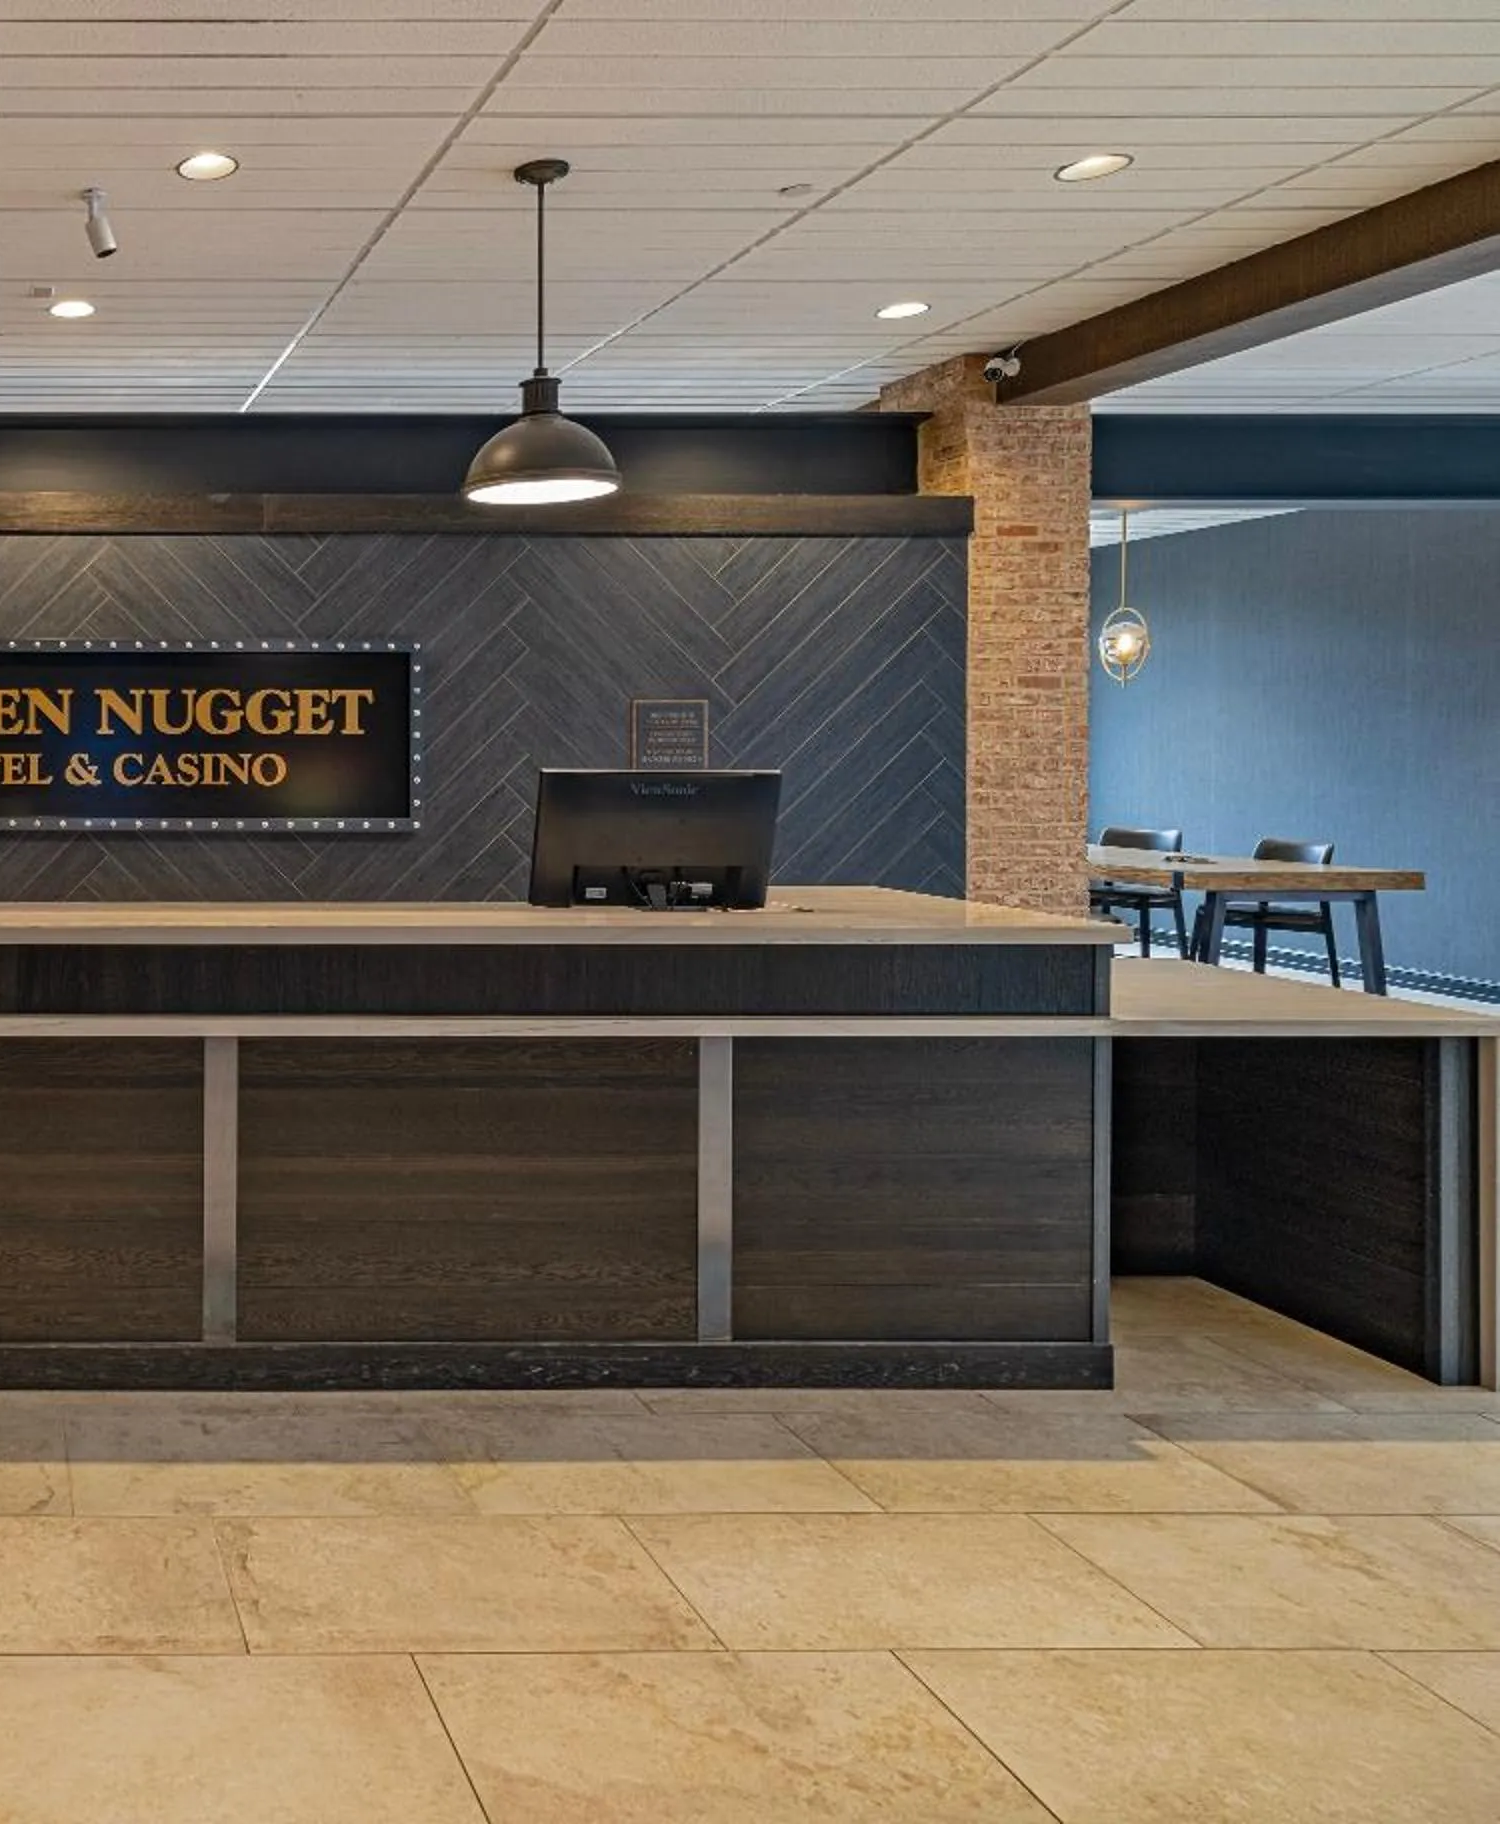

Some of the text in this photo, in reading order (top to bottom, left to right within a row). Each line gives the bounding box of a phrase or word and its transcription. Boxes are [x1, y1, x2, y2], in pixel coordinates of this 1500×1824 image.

[93, 688, 375, 736] NUGGET
[63, 752, 102, 788] &
[112, 752, 288, 788] CASINO
[630, 782, 700, 796] ViewSonic
